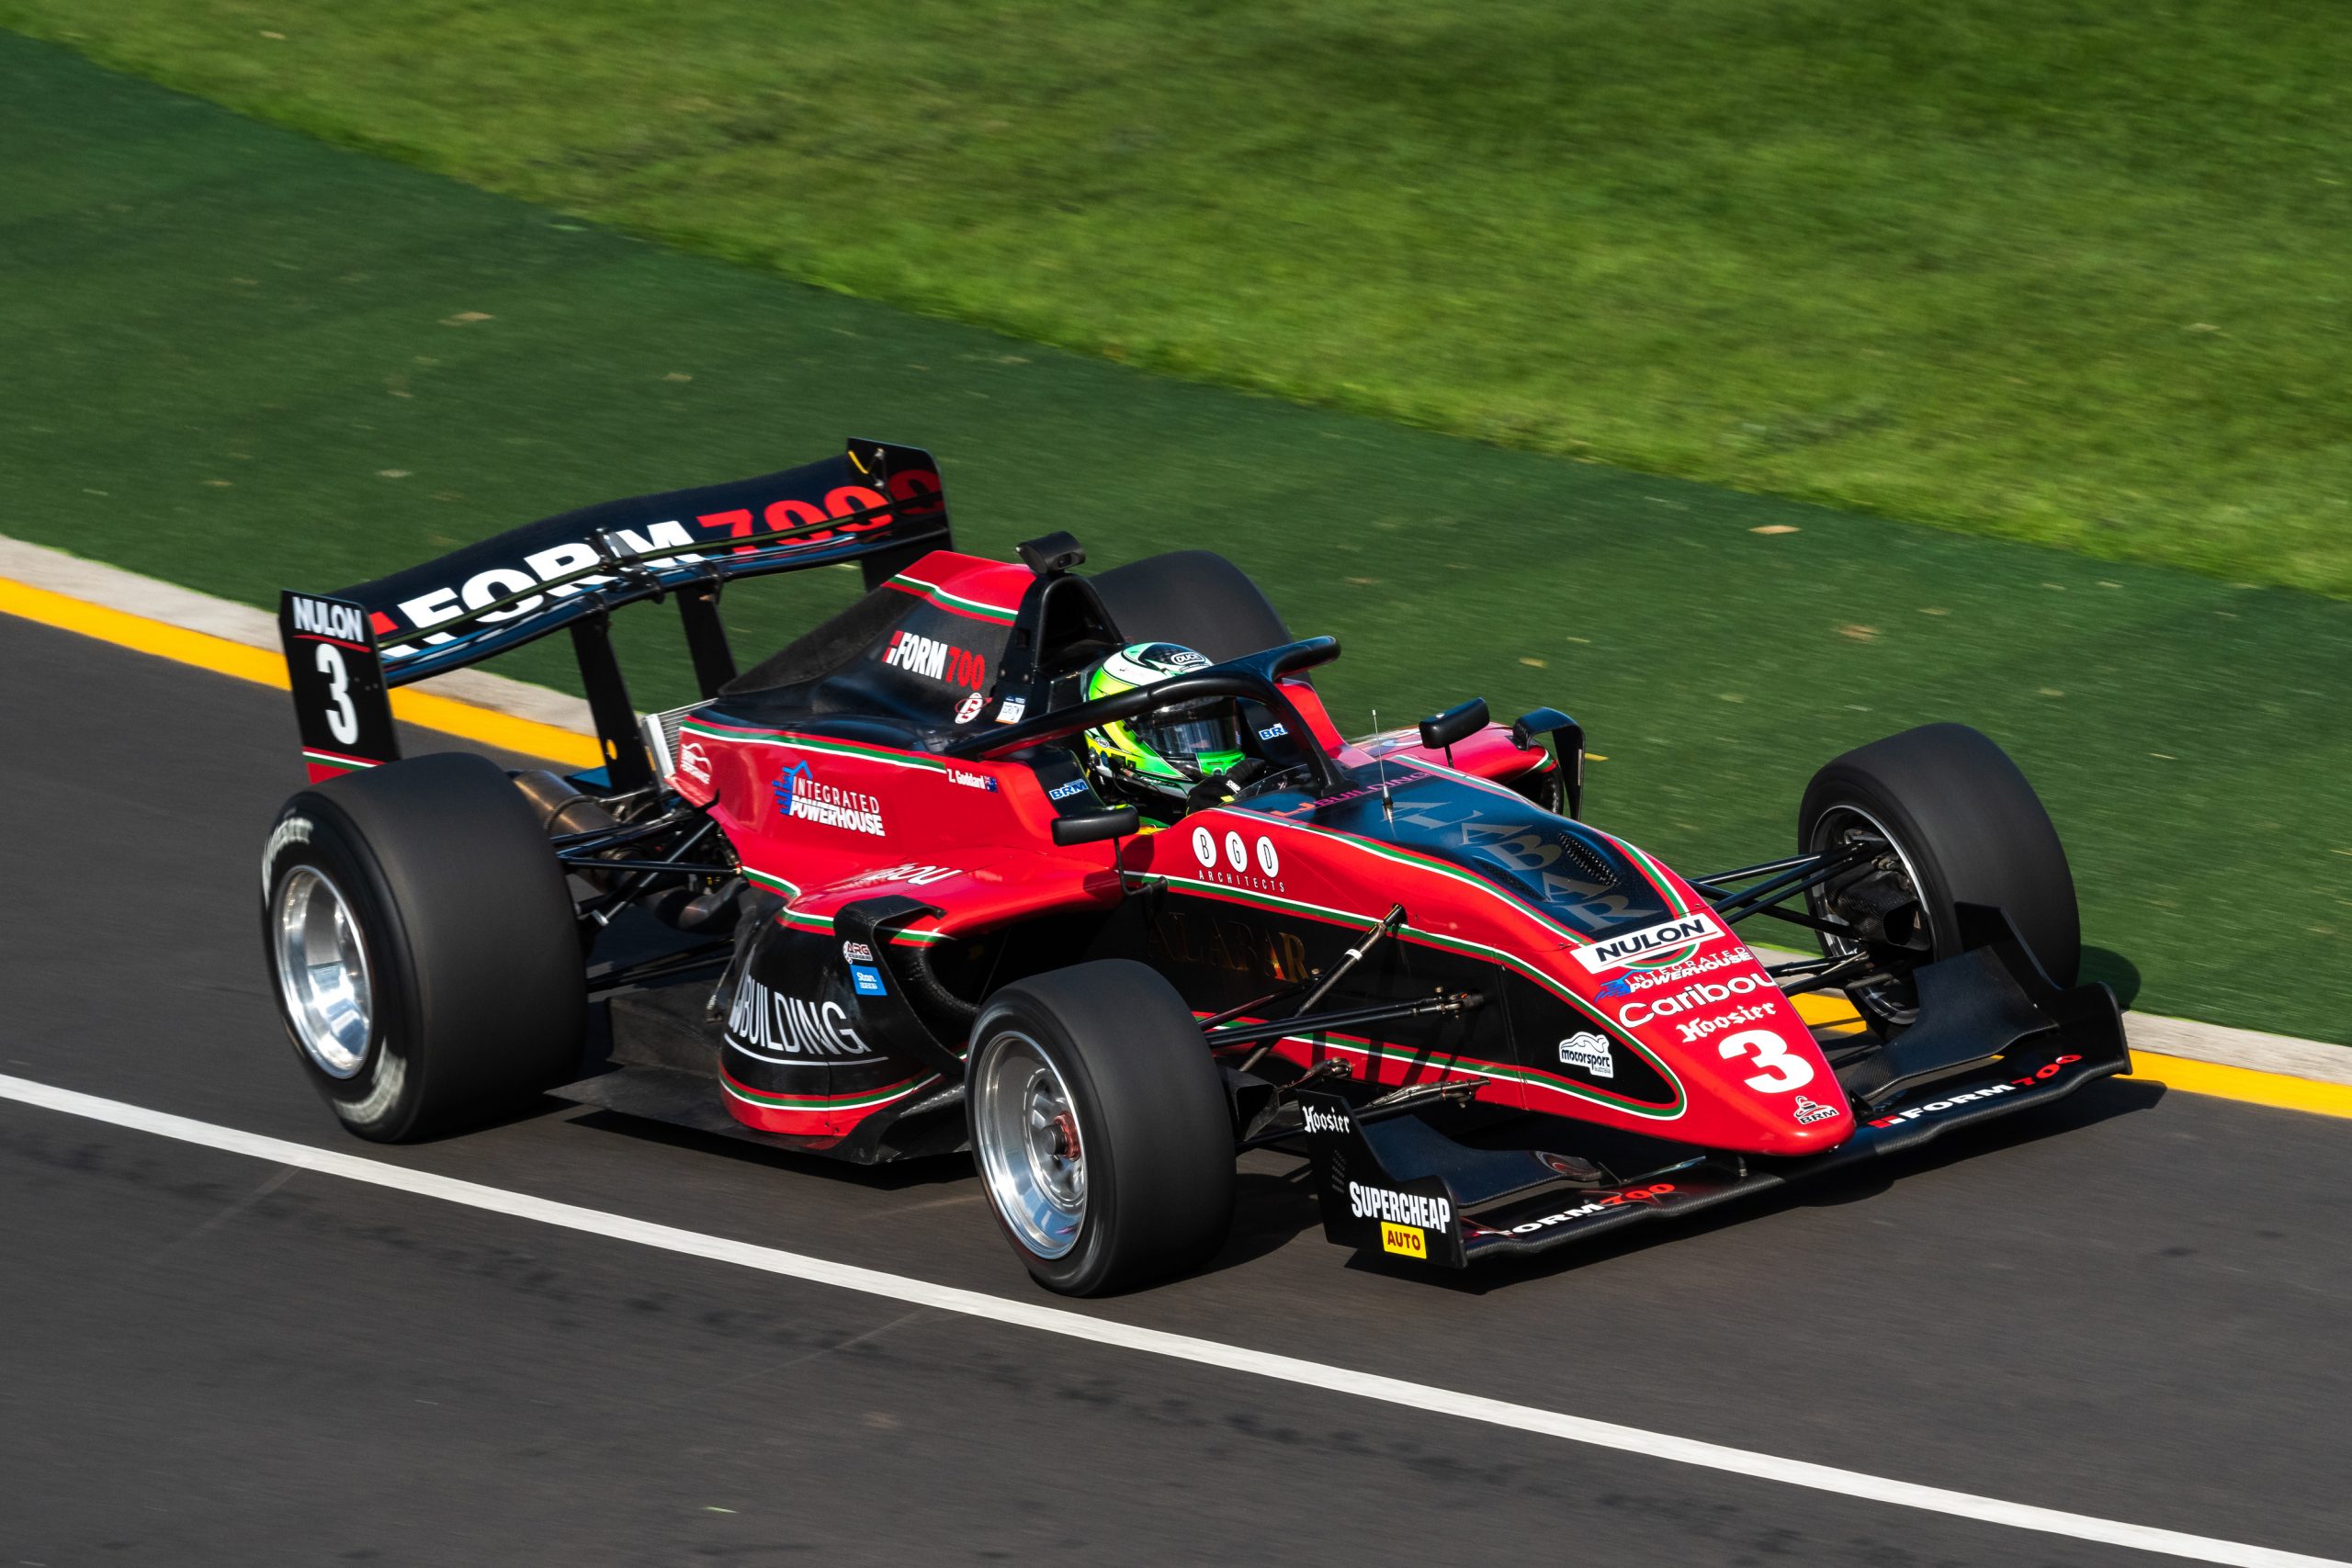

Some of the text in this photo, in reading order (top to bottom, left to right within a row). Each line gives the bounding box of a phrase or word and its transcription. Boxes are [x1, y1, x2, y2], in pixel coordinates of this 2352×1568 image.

[292, 596, 364, 643] NULON
[314, 644, 359, 745] 3
[793, 776, 879, 813] INTEGRATED
[1049, 781, 1089, 800] BRM
[789, 795, 886, 837] POWERHOUSE
[1199, 870, 1284, 893] ARCHITECTS
[847, 943, 871, 955] ARG
[1595, 919, 1706, 962] NULON
[1625, 947, 1746, 985] INTEGRATED
[1630, 952, 1754, 993] POWERHOUSE
[1676, 1002, 1776, 1043] Hoosier
[1561, 1049, 1610, 1071] motorsport
[1718, 1030, 1815, 1093] 3
[1302, 1105, 1350, 1134] Hoosier
[1801, 1108, 1838, 1124] BRM
[1349, 1181, 1451, 1234] SUPERCHEAP
[1386, 1229, 1421, 1251] AUTO
